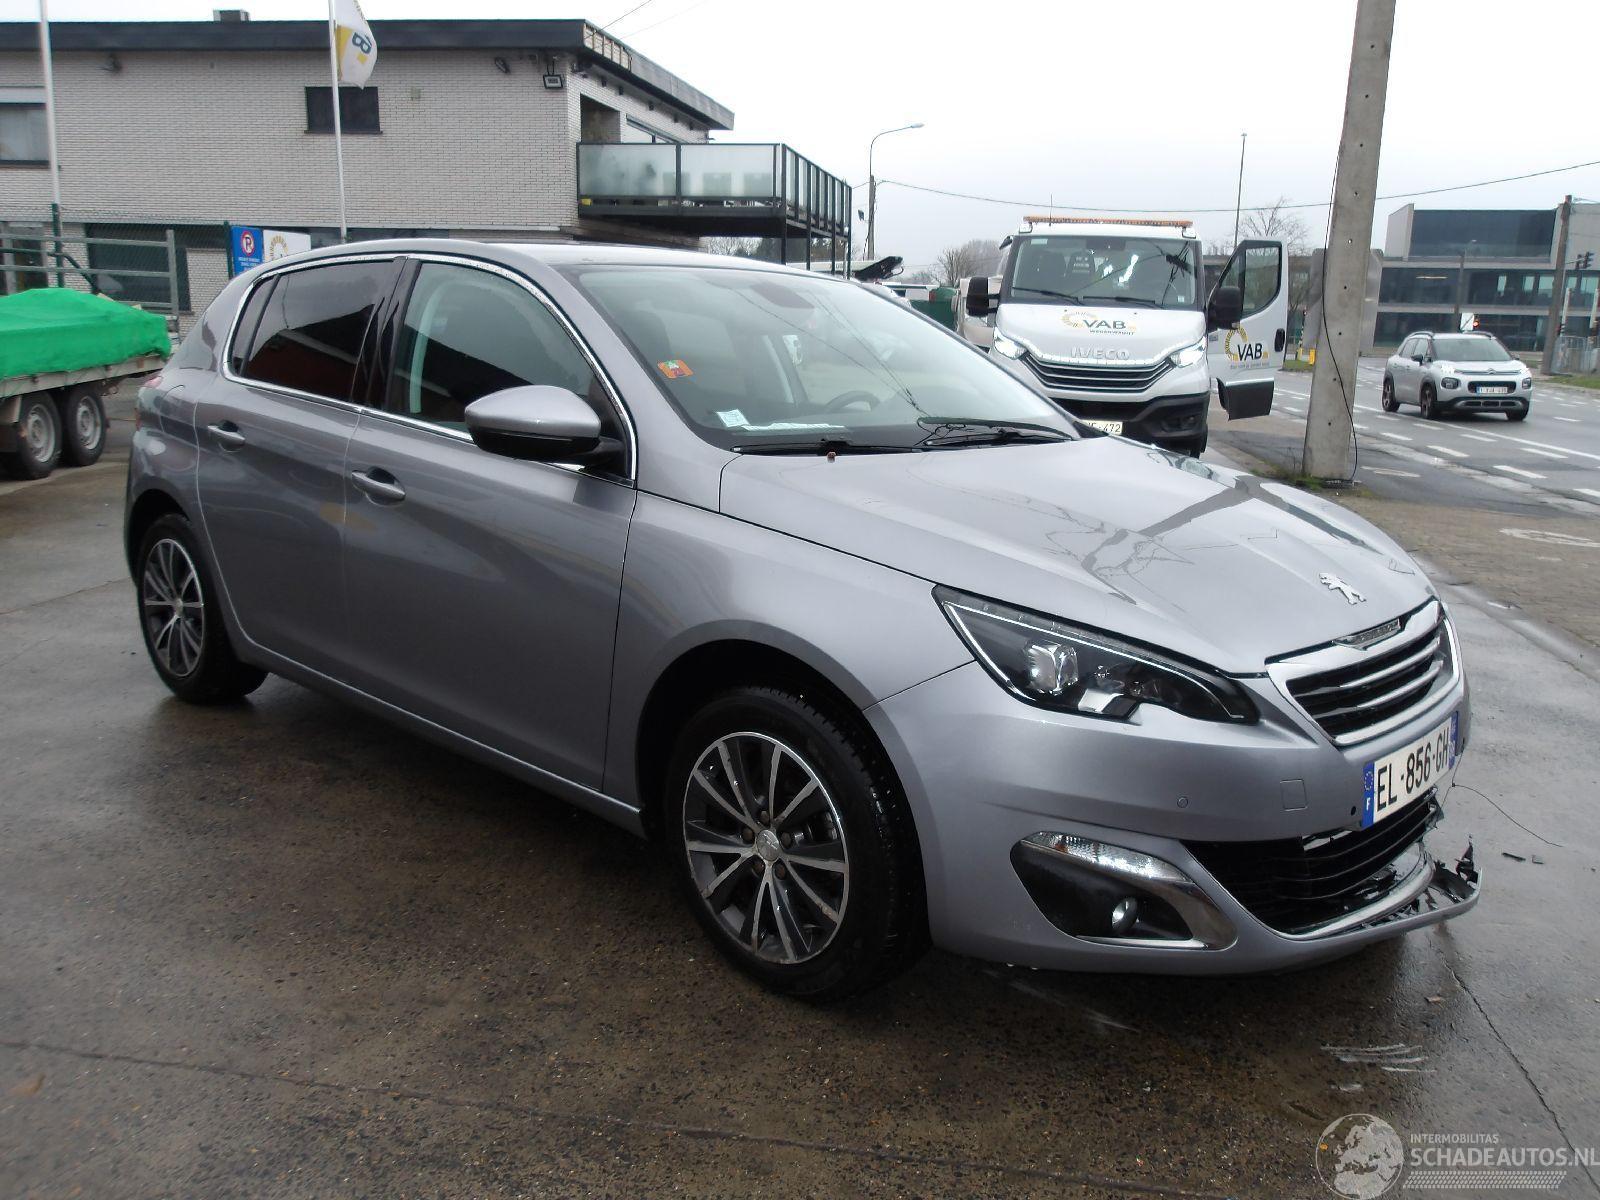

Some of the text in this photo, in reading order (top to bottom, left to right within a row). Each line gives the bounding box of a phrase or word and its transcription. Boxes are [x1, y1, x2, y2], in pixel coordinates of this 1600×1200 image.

[1083, 319, 1126, 329] VAB
[1071, 346, 1130, 361] IVECO
[1237, 343, 1263, 361] VAB
